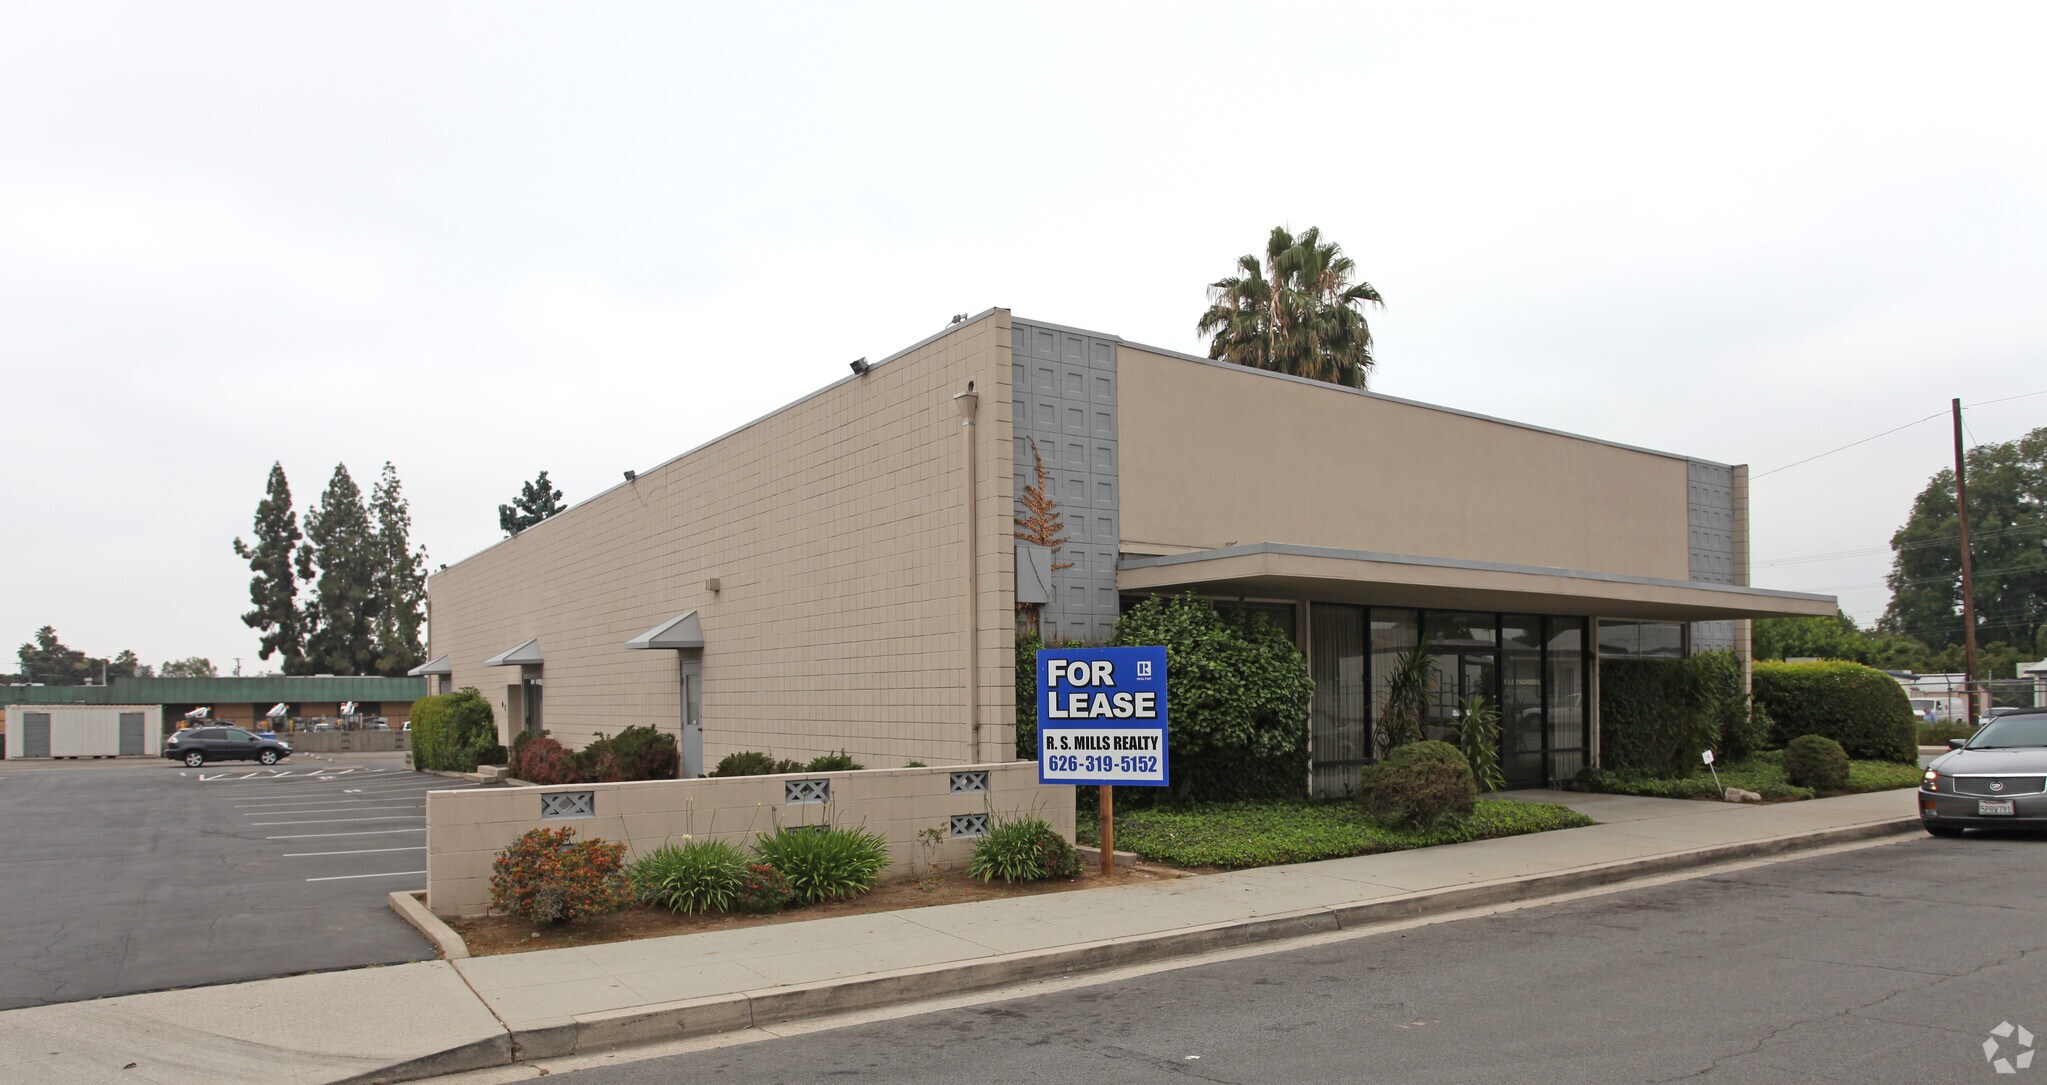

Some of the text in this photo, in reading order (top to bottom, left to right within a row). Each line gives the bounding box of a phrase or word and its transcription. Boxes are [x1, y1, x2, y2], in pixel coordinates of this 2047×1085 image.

[1047, 659, 1115, 687] FOR
[1048, 691, 1156, 718] LEASE
[1046, 735, 1159, 751] R. S. MILLS REALTY
[1048, 755, 1158, 773] 626-319-5152
